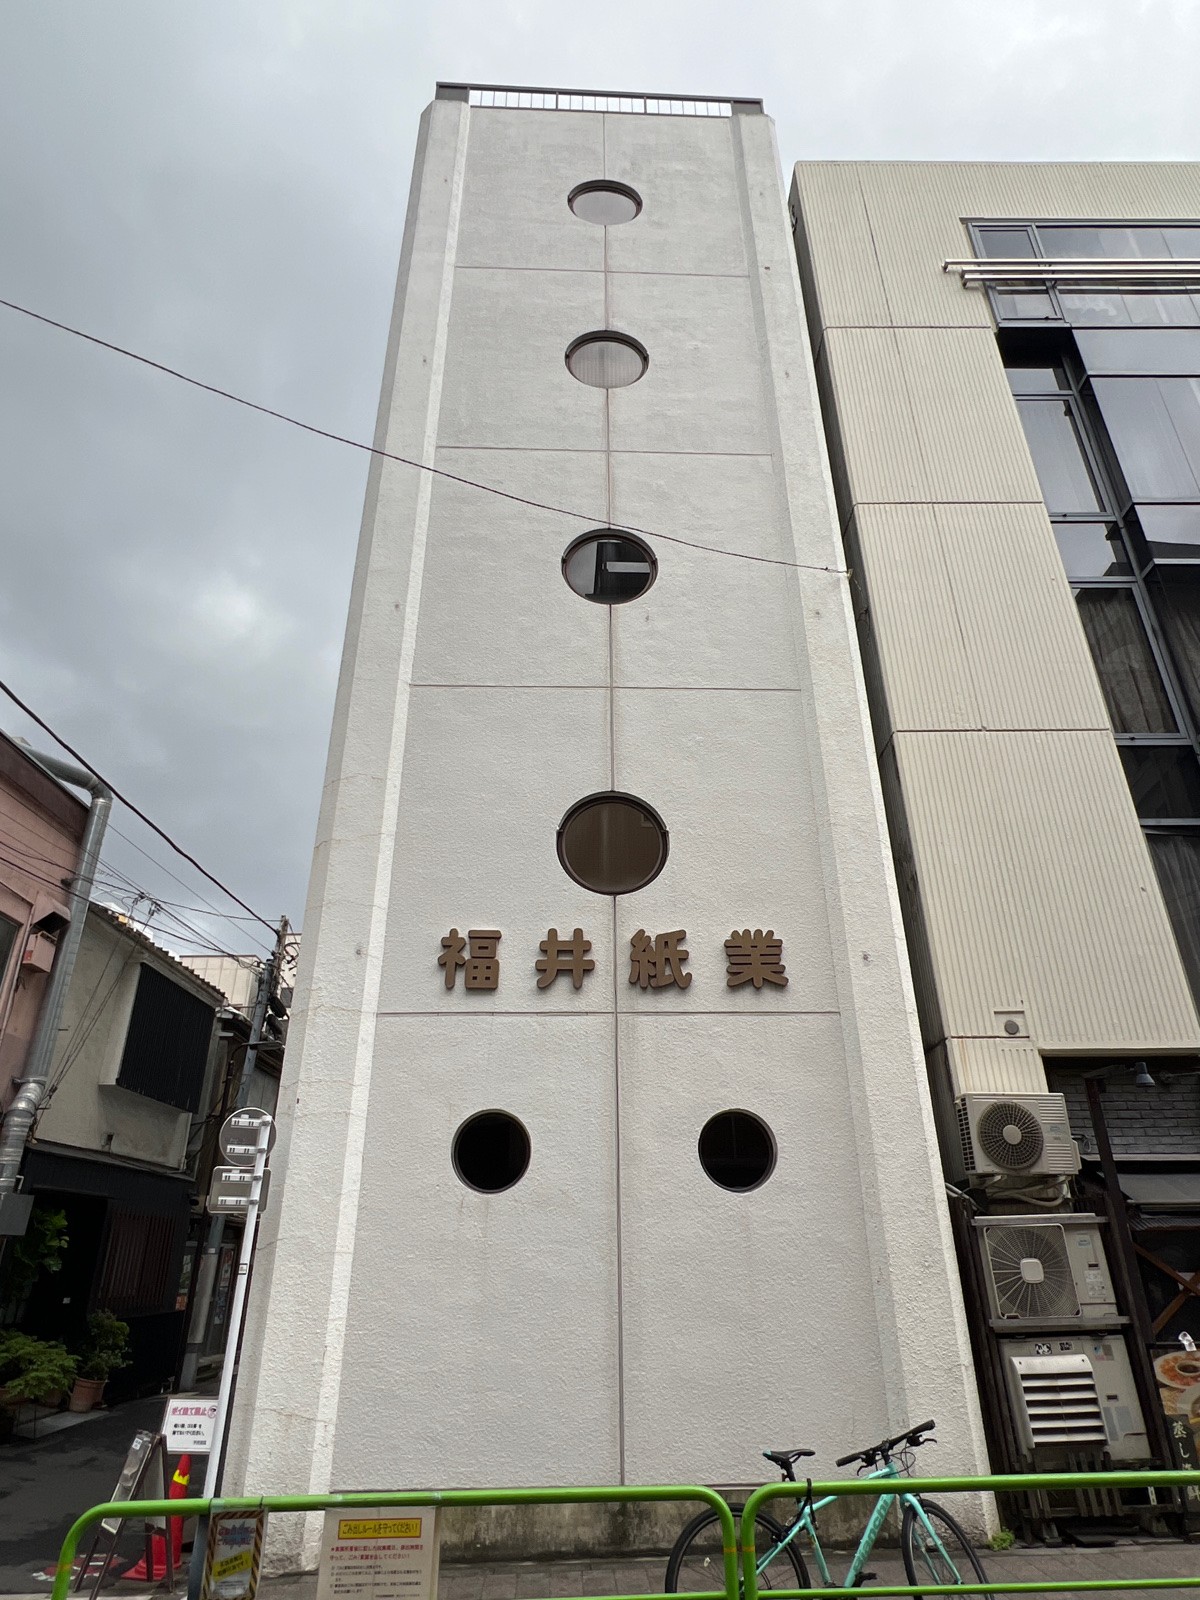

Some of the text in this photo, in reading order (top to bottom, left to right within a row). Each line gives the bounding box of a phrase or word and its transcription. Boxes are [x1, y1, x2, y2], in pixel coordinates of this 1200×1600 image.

[437, 927, 790, 990] 福井紙業
[172, 1406, 207, 1416] ポイ捨て禁止
[853, 1495, 891, 1573] Bianchi
